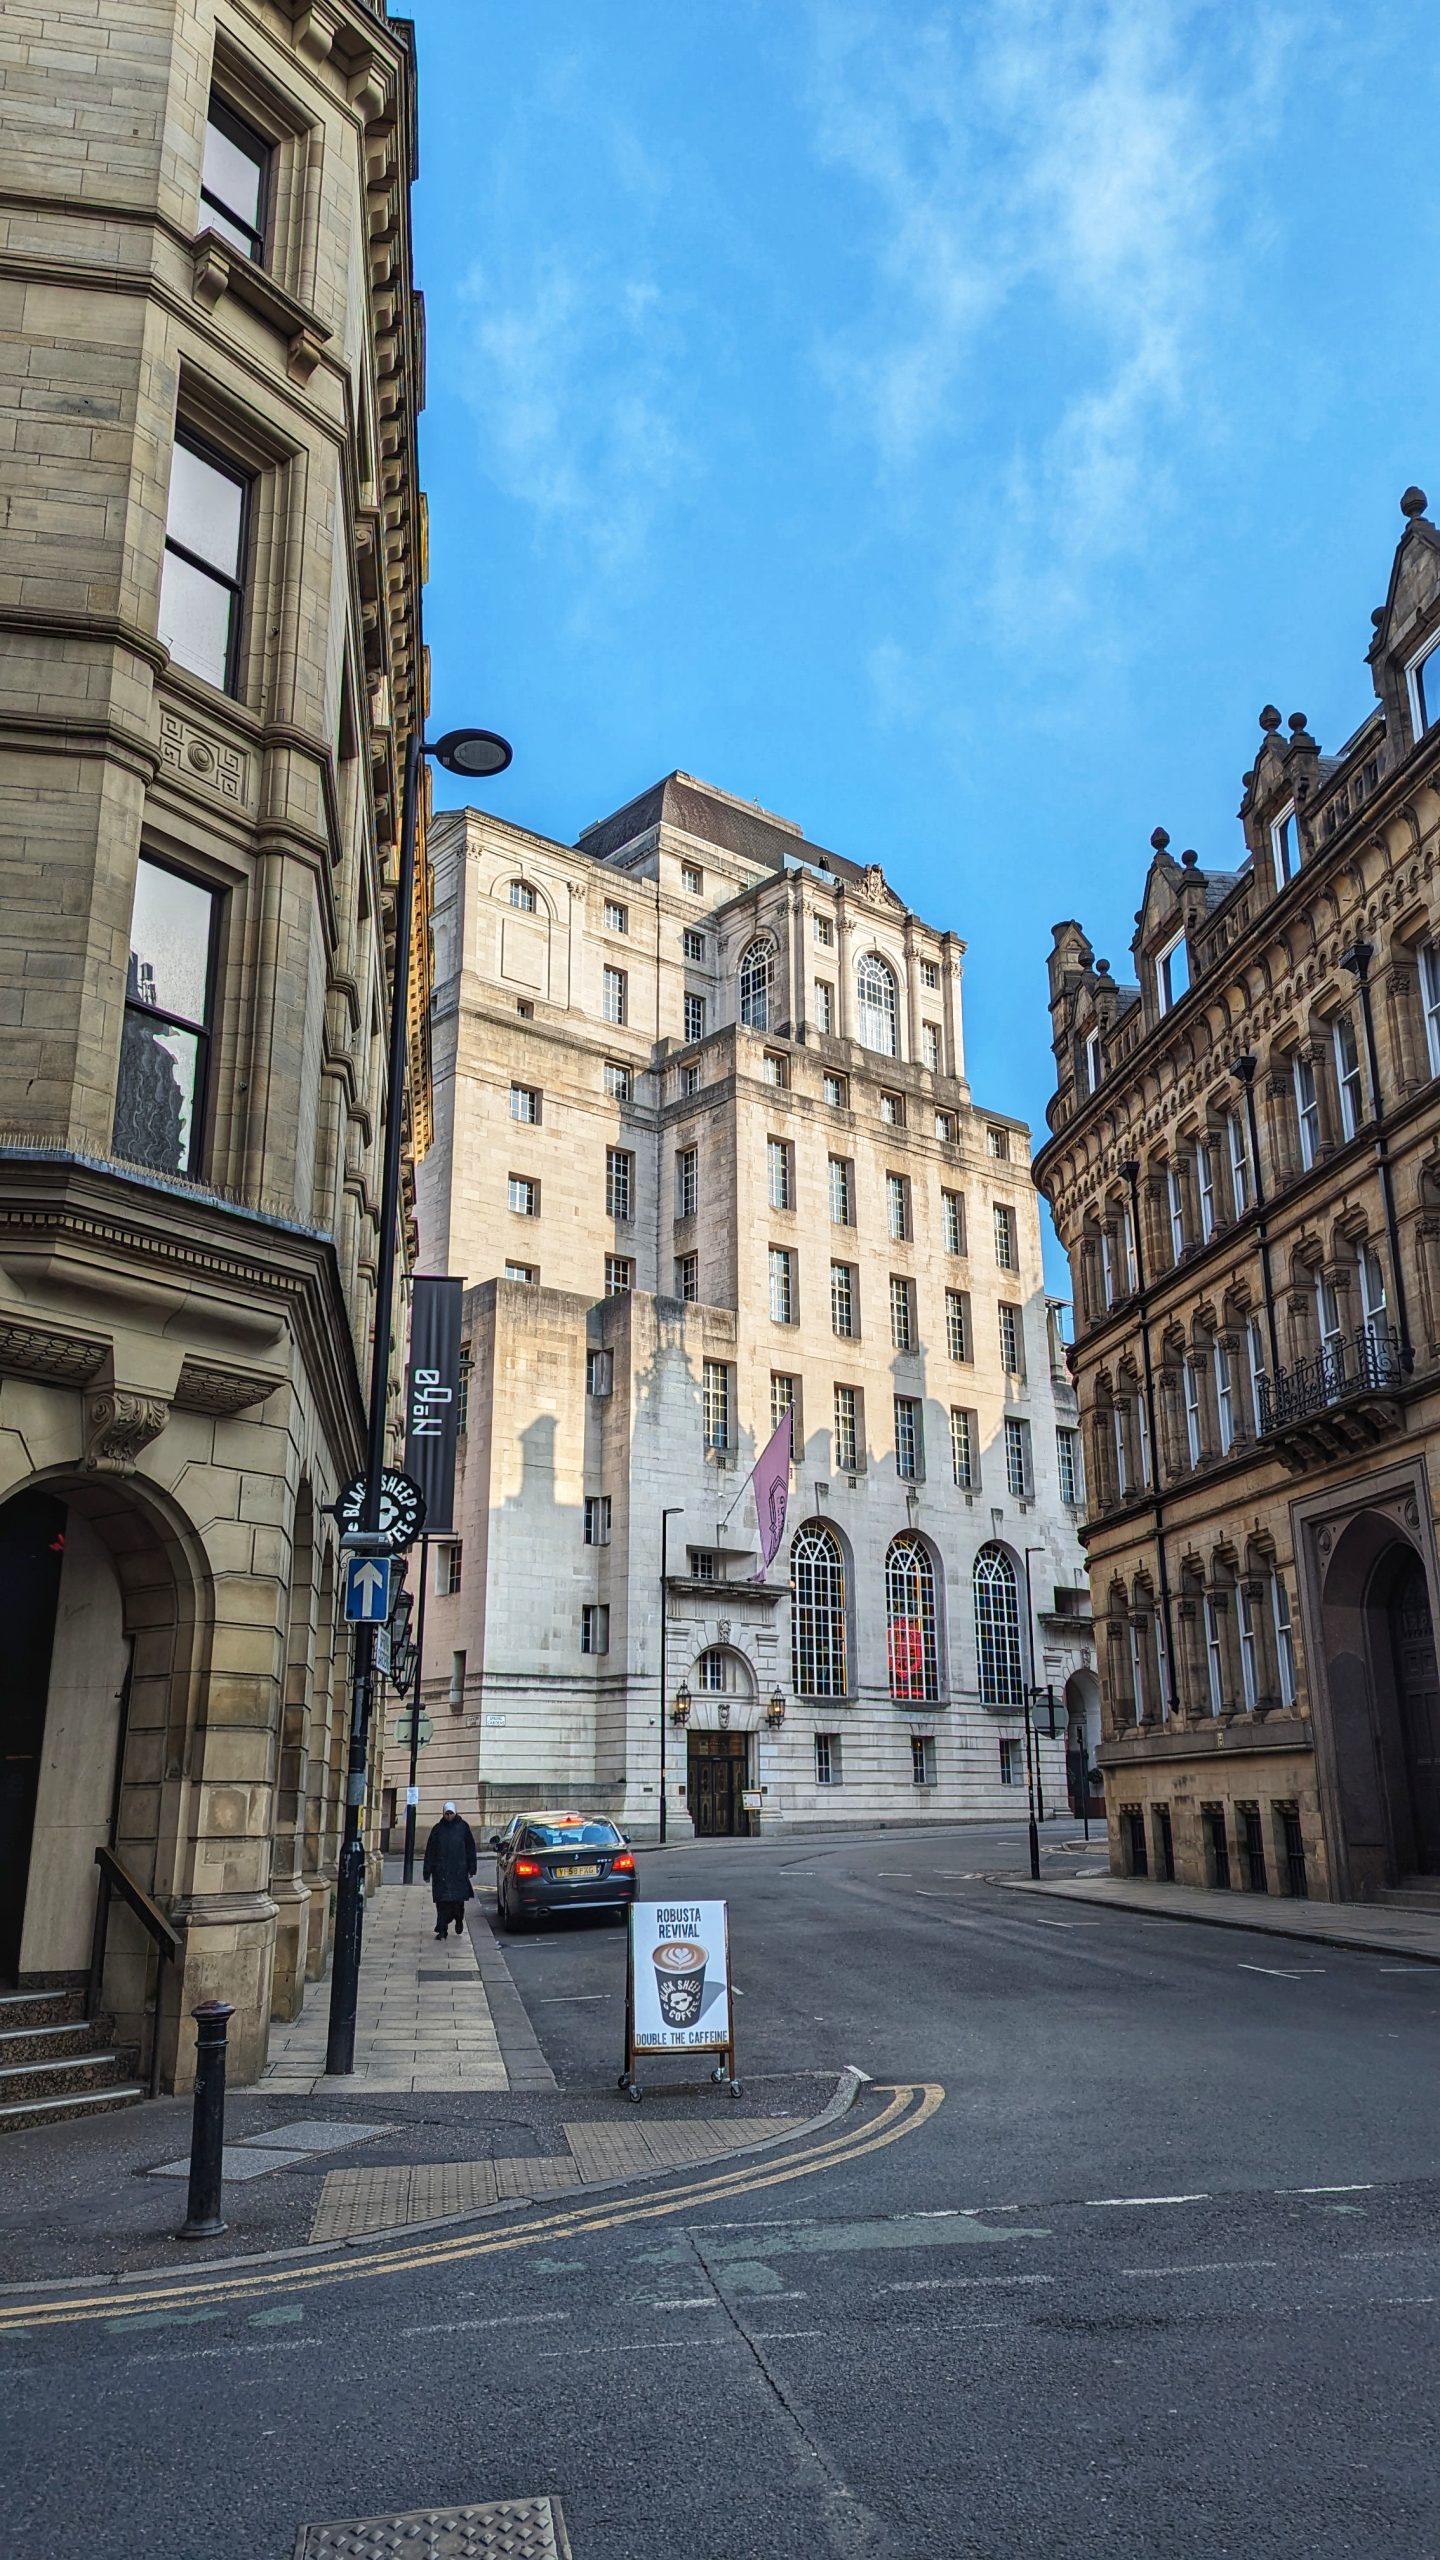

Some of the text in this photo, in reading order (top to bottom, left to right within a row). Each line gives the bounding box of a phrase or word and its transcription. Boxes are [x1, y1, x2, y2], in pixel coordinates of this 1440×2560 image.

[342, 1474, 418, 1518] BLAC SHEEP
[656, 1908, 702, 1923] ROBUSTA
[658, 1923, 700, 1939] REVIVAL
[668, 2000, 700, 2022] COFFEE
[636, 2030, 728, 2046] DOUBLE THE CAFFEINE
